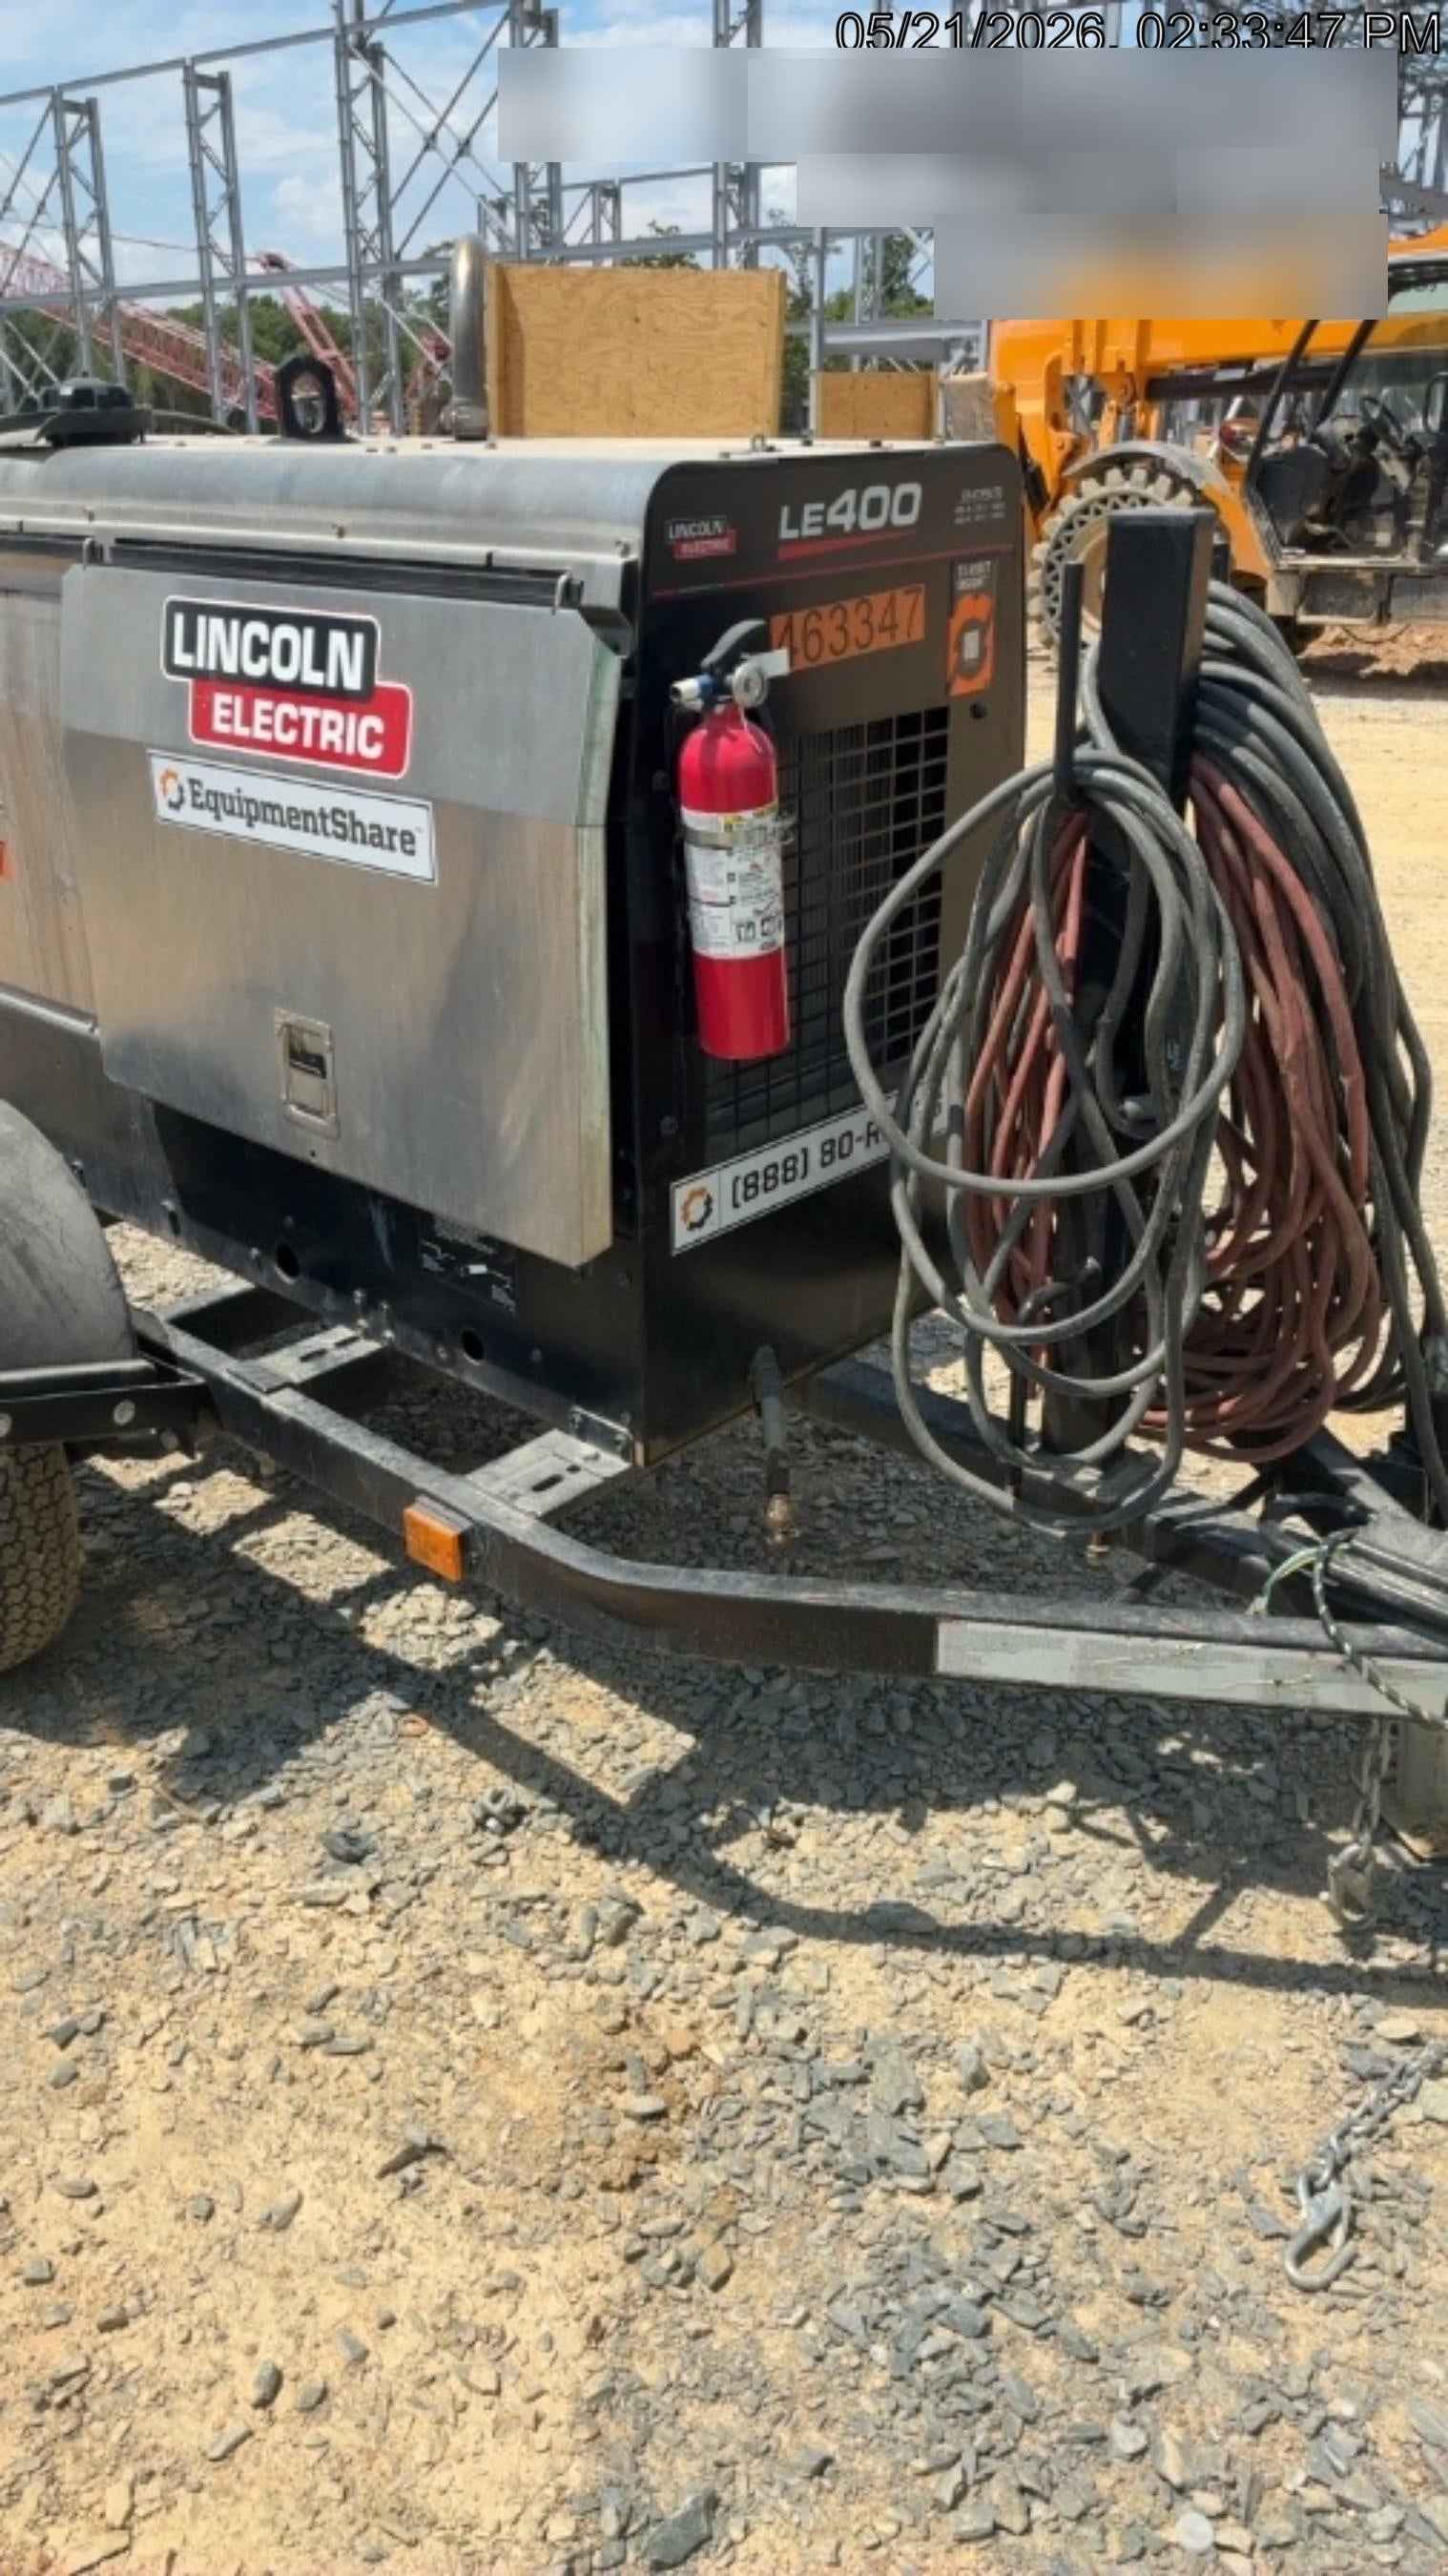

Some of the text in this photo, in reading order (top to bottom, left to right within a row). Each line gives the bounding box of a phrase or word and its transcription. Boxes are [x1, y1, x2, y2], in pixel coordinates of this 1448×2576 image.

[669, 519, 723, 539] LINCOLN
[778, 482, 922, 540] LE400
[173, 612, 364, 691] LINCOLN
[777, 586, 922, 668] 463347
[211, 692, 384, 759] ELECTRIC
[188, 778, 417, 857] EquipmentShare
[732, 1122, 879, 1209] (888) 80-R
